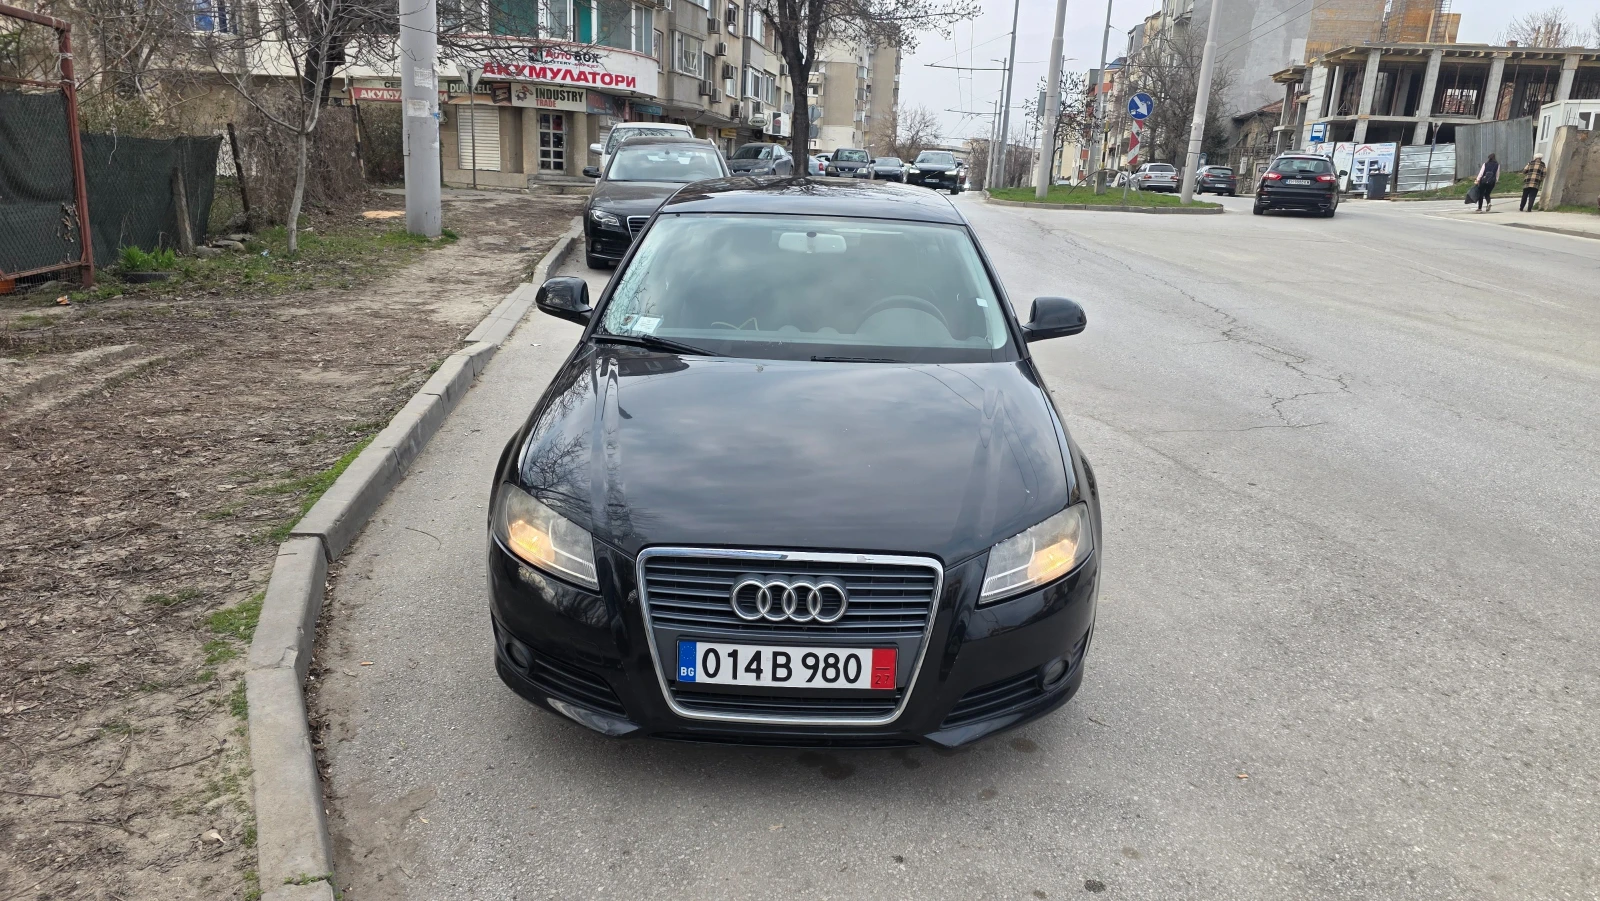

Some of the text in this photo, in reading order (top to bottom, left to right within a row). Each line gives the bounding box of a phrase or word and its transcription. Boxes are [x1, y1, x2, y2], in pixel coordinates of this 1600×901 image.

[574, 51, 599, 63] BOX
[482, 62, 636, 88] АКУМУЛАТОРИ
[449, 83, 492, 95] DURCELL
[535, 88, 584, 103] INDUSTRY
[535, 98, 556, 108] TRADE
[680, 667, 695, 677] BG
[875, 674, 890, 685] 27
